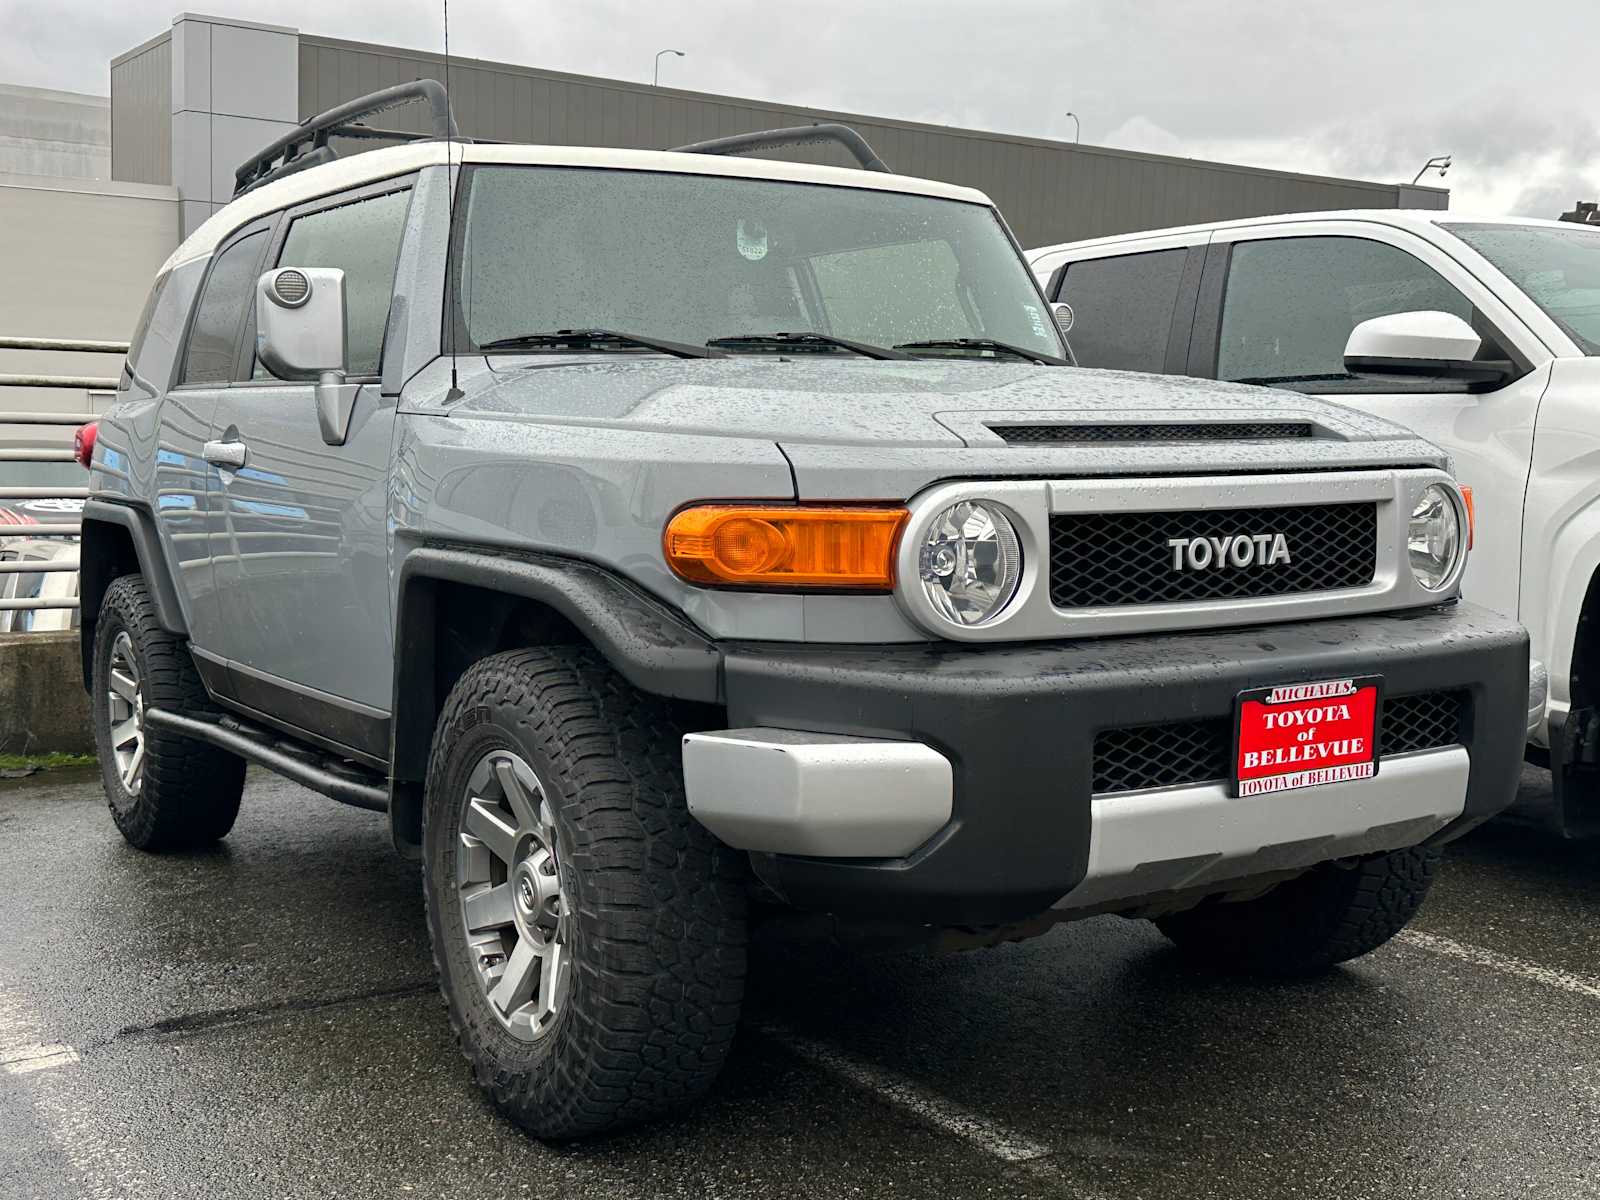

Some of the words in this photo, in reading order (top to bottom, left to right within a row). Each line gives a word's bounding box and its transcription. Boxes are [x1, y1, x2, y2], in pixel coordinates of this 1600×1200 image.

[1168, 533, 1292, 571] TOYOTA
[1273, 681, 1352, 702] MICHAELS
[1263, 704, 1351, 729] TOYOTA
[1296, 727, 1317, 742] of
[1243, 738, 1364, 769] BELLEVUE
[1241, 776, 1288, 795] TOYOTA
[1291, 774, 1306, 787] of
[1308, 763, 1374, 784] BELLEVUE
